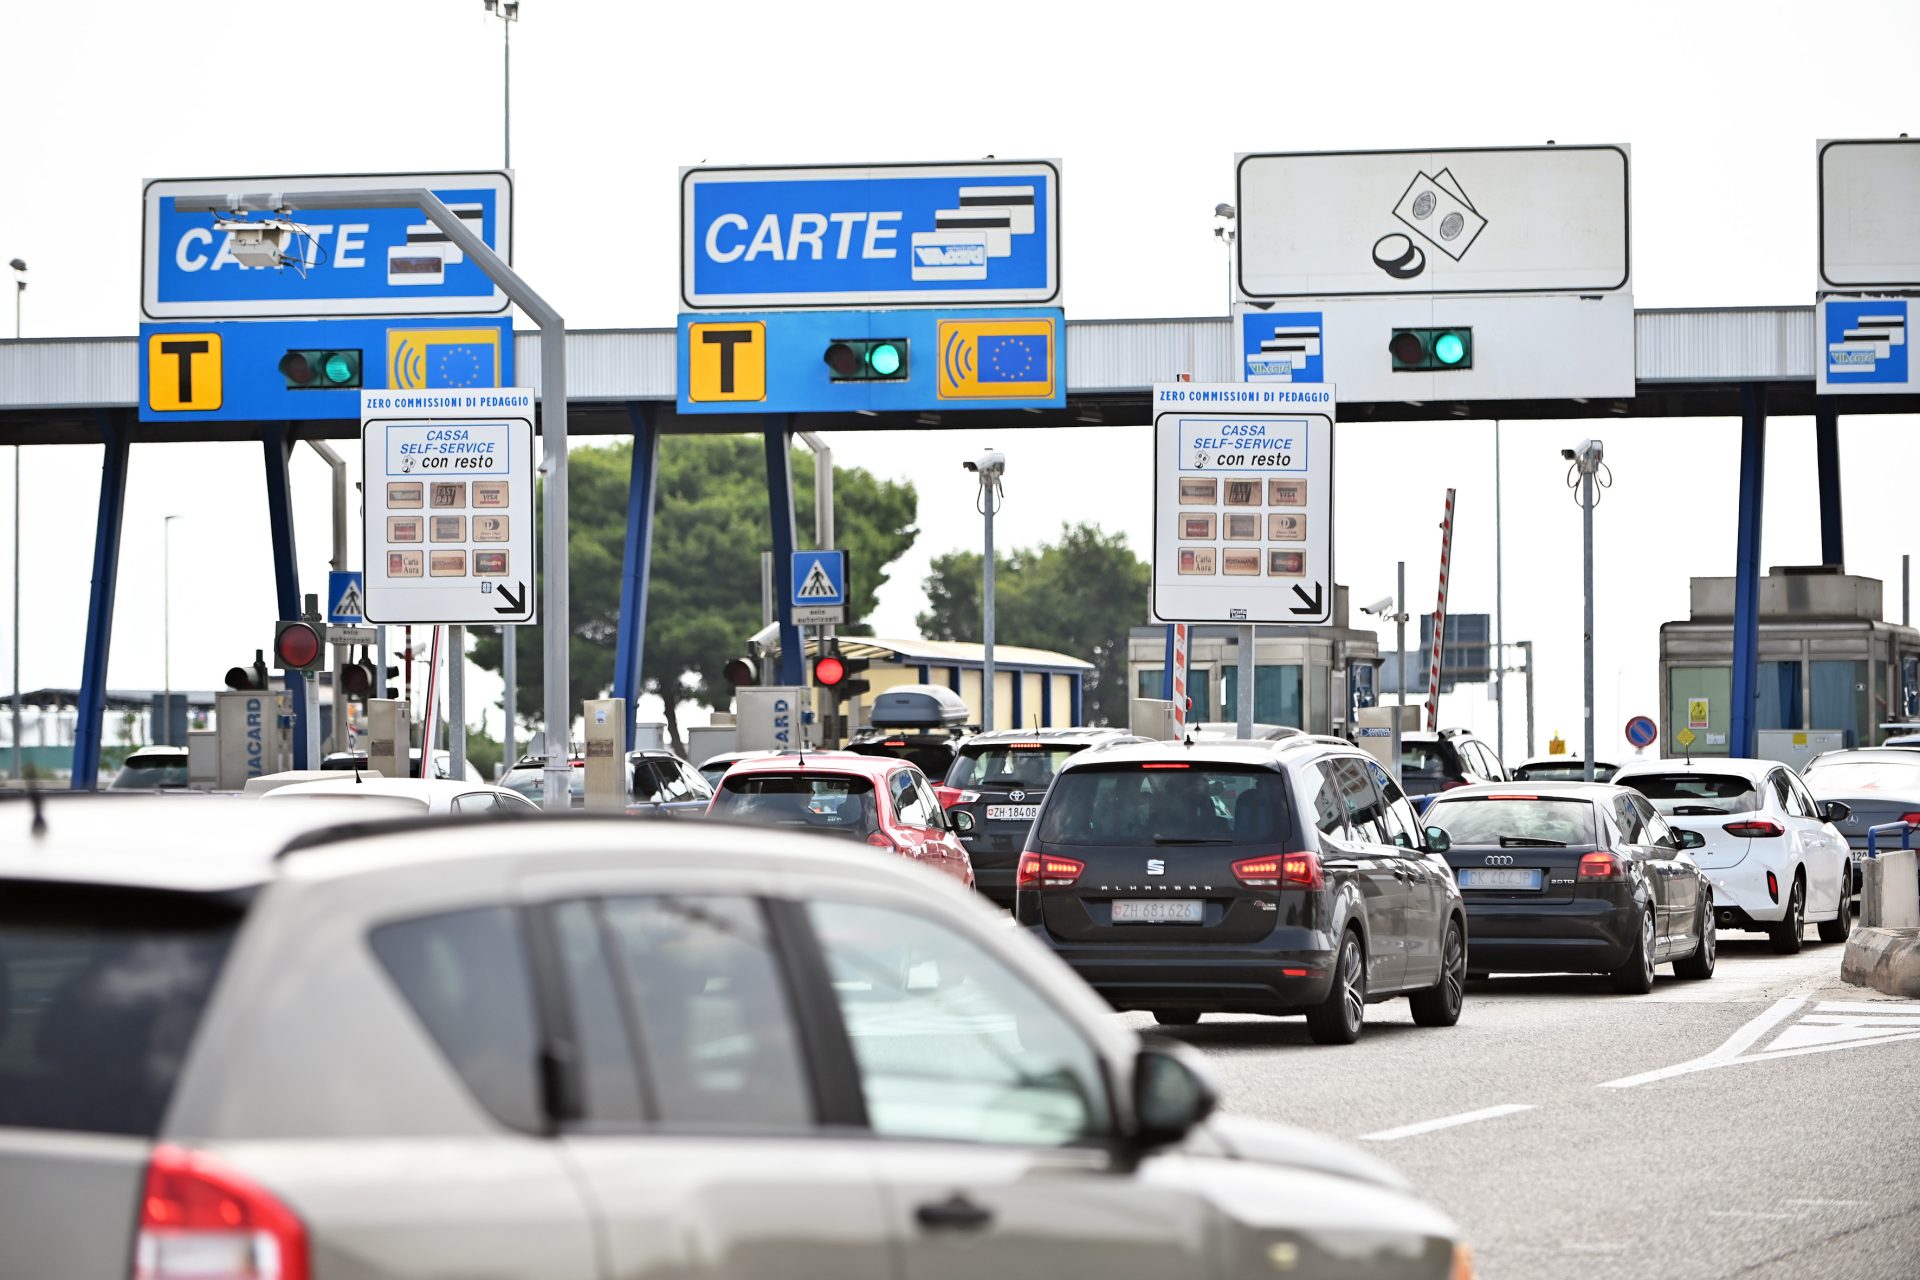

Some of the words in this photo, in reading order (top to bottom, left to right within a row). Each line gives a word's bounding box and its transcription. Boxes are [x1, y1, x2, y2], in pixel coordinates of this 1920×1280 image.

[704, 211, 903, 263] CARTE
[175, 223, 370, 273] CATE
[702, 330, 752, 393] T
[161, 341, 209, 403] T
[367, 398, 391, 408] ZERO
[395, 397, 462, 408] COMMISSIONI
[466, 397, 476, 407] DI
[480, 396, 529, 407] PEDAGGIO
[1160, 391, 1185, 400] ZERO
[1190, 391, 1259, 401] COMMISSIONI
[1264, 392, 1275, 401] DI
[1280, 392, 1329, 402] PEDAGGIO
[426, 430, 469, 441] CASSA
[1221, 425, 1266, 436] CASSA
[400, 442, 495, 455] SELF-SERVICE
[1193, 438, 1293, 450] SELF-SERVICE
[422, 457, 448, 468] con
[454, 455, 493, 468] resto
[1217, 454, 1244, 466] con
[1251, 452, 1291, 466] resto
[403, 557, 419, 566] Carta
[403, 565, 419, 574] Aura
[993, 807, 1005, 817] ZH
[1122, 904, 1138, 917] ZH
